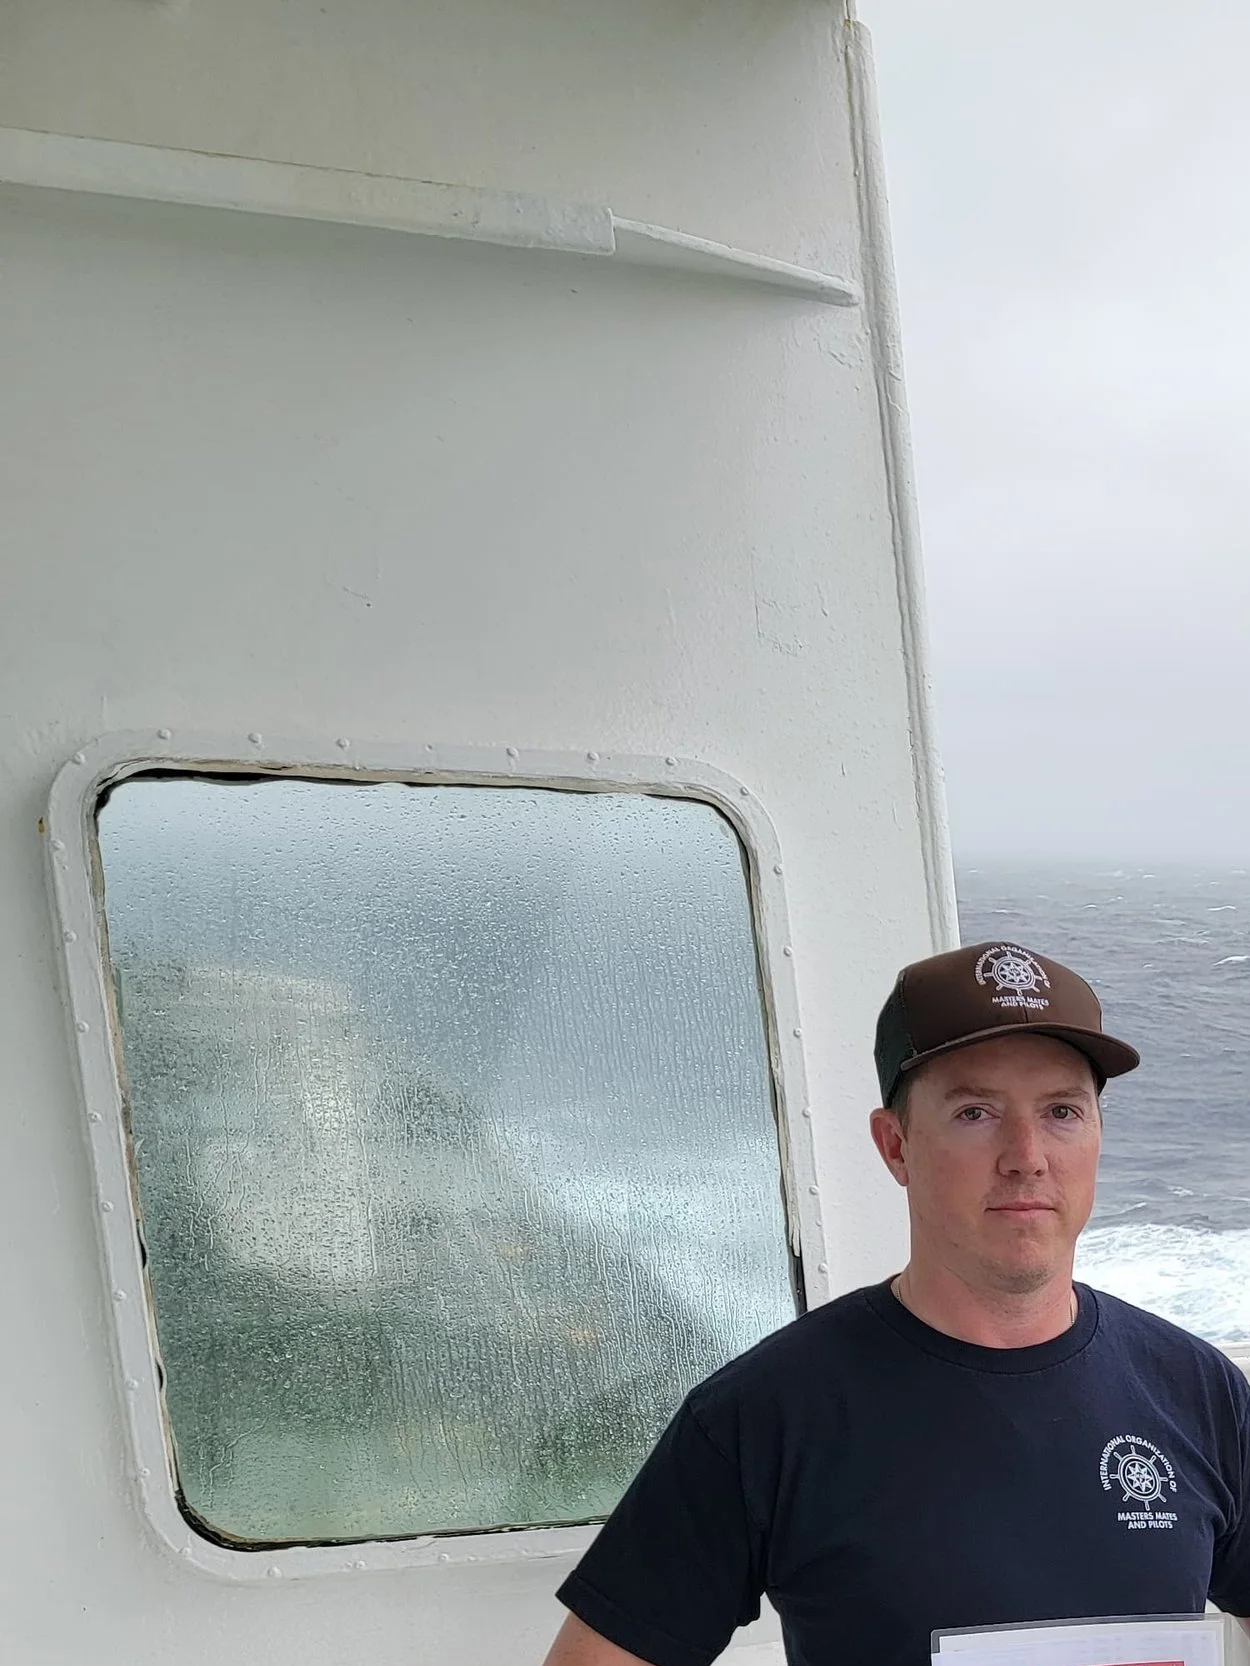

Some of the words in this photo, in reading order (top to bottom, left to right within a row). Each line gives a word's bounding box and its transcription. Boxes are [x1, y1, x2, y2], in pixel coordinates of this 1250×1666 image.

[1100, 1435, 1126, 1490] INTERNATIONAL
[1125, 1435, 1175, 1478] ORGANIZATION
[1169, 1480, 1177, 1493] OF
[1117, 1512, 1154, 1521] MASTERS
[1155, 1512, 1177, 1521] MATES
[1127, 1521, 1147, 1529] AND
[1148, 1521, 1173, 1529] PILOTS
